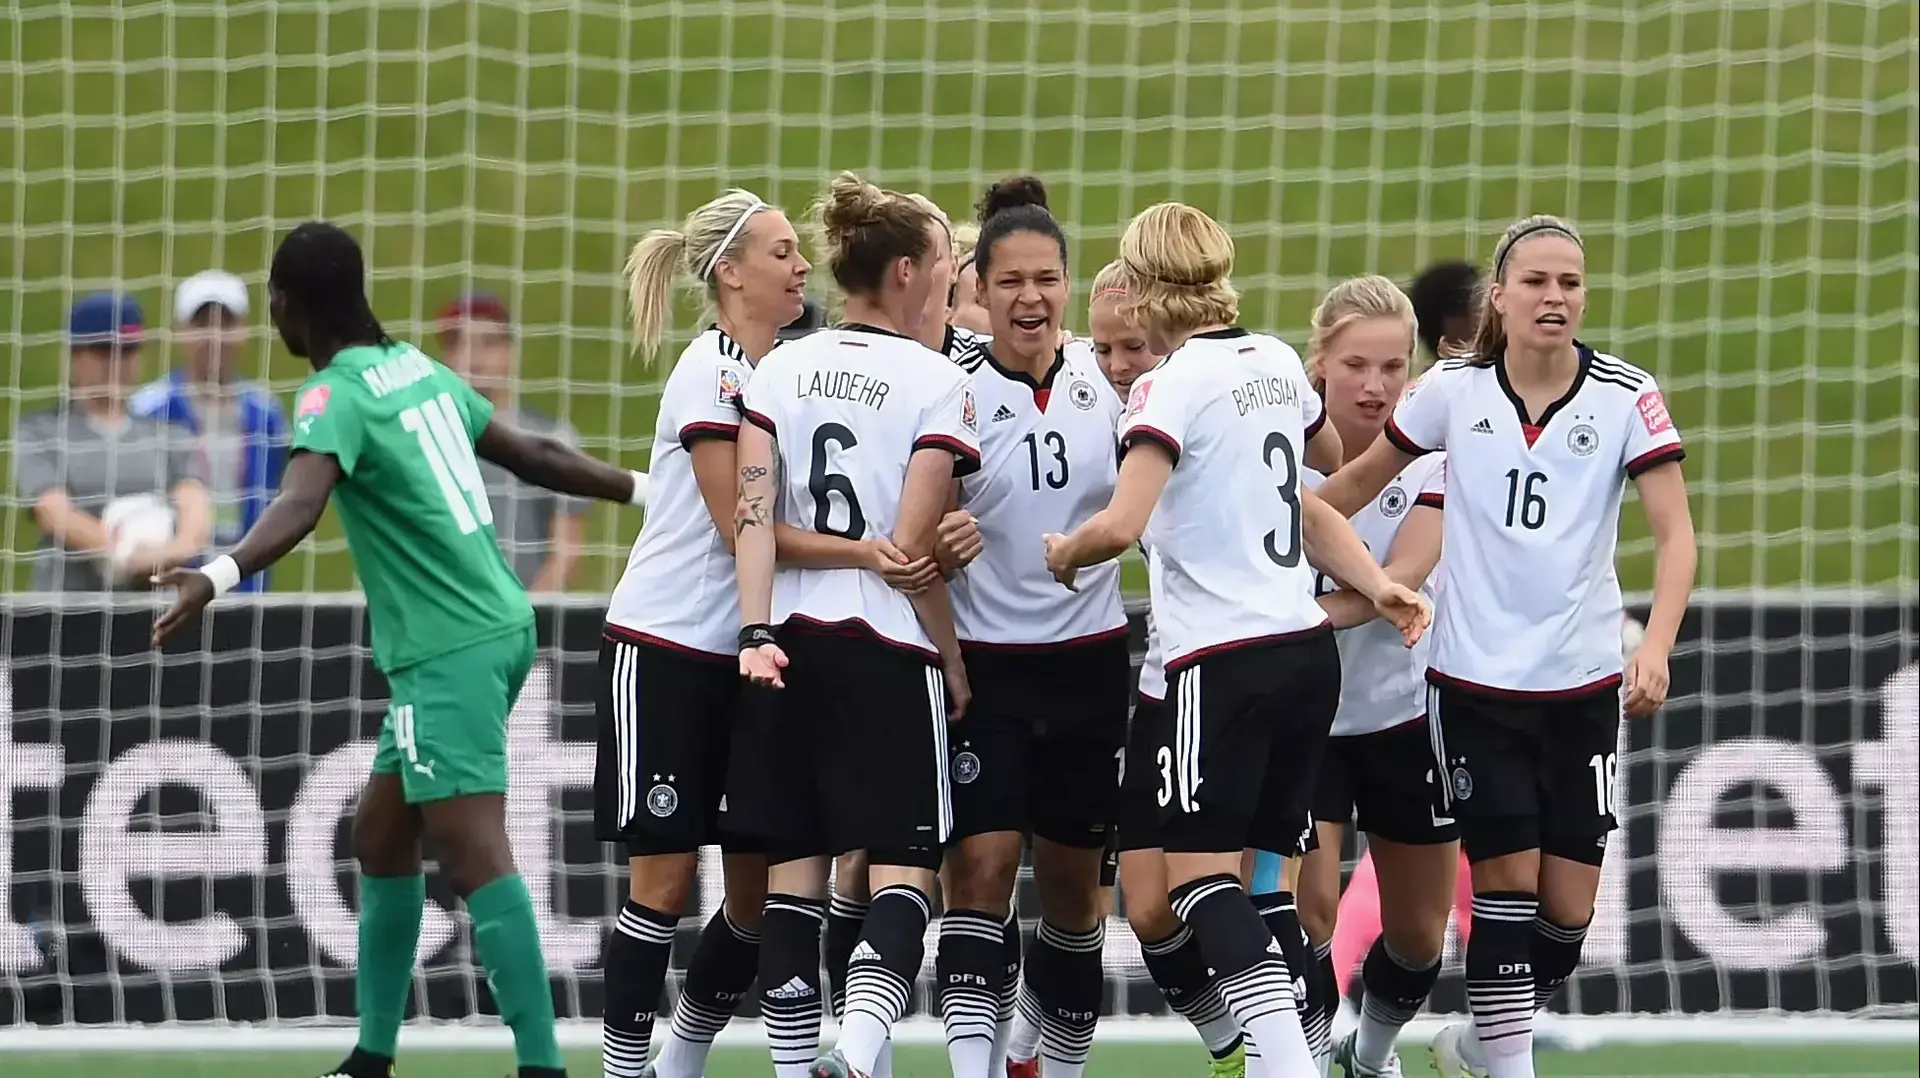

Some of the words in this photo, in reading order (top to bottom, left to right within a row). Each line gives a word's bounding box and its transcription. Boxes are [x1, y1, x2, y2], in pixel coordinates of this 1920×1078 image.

[797, 370, 890, 411] LAUDEHR
[399, 392, 494, 536] 14
[808, 421, 867, 541] 6
[1022, 430, 1069, 491] 13
[1262, 431, 1301, 568] 3
[1504, 468, 1549, 530] 16
[1157, 745, 1173, 807] 3
[766, 987, 816, 999] adidas
[949, 973, 987, 986] DFB
[1499, 963, 1532, 975] DFB
[1058, 1007, 1094, 1021] DFB
